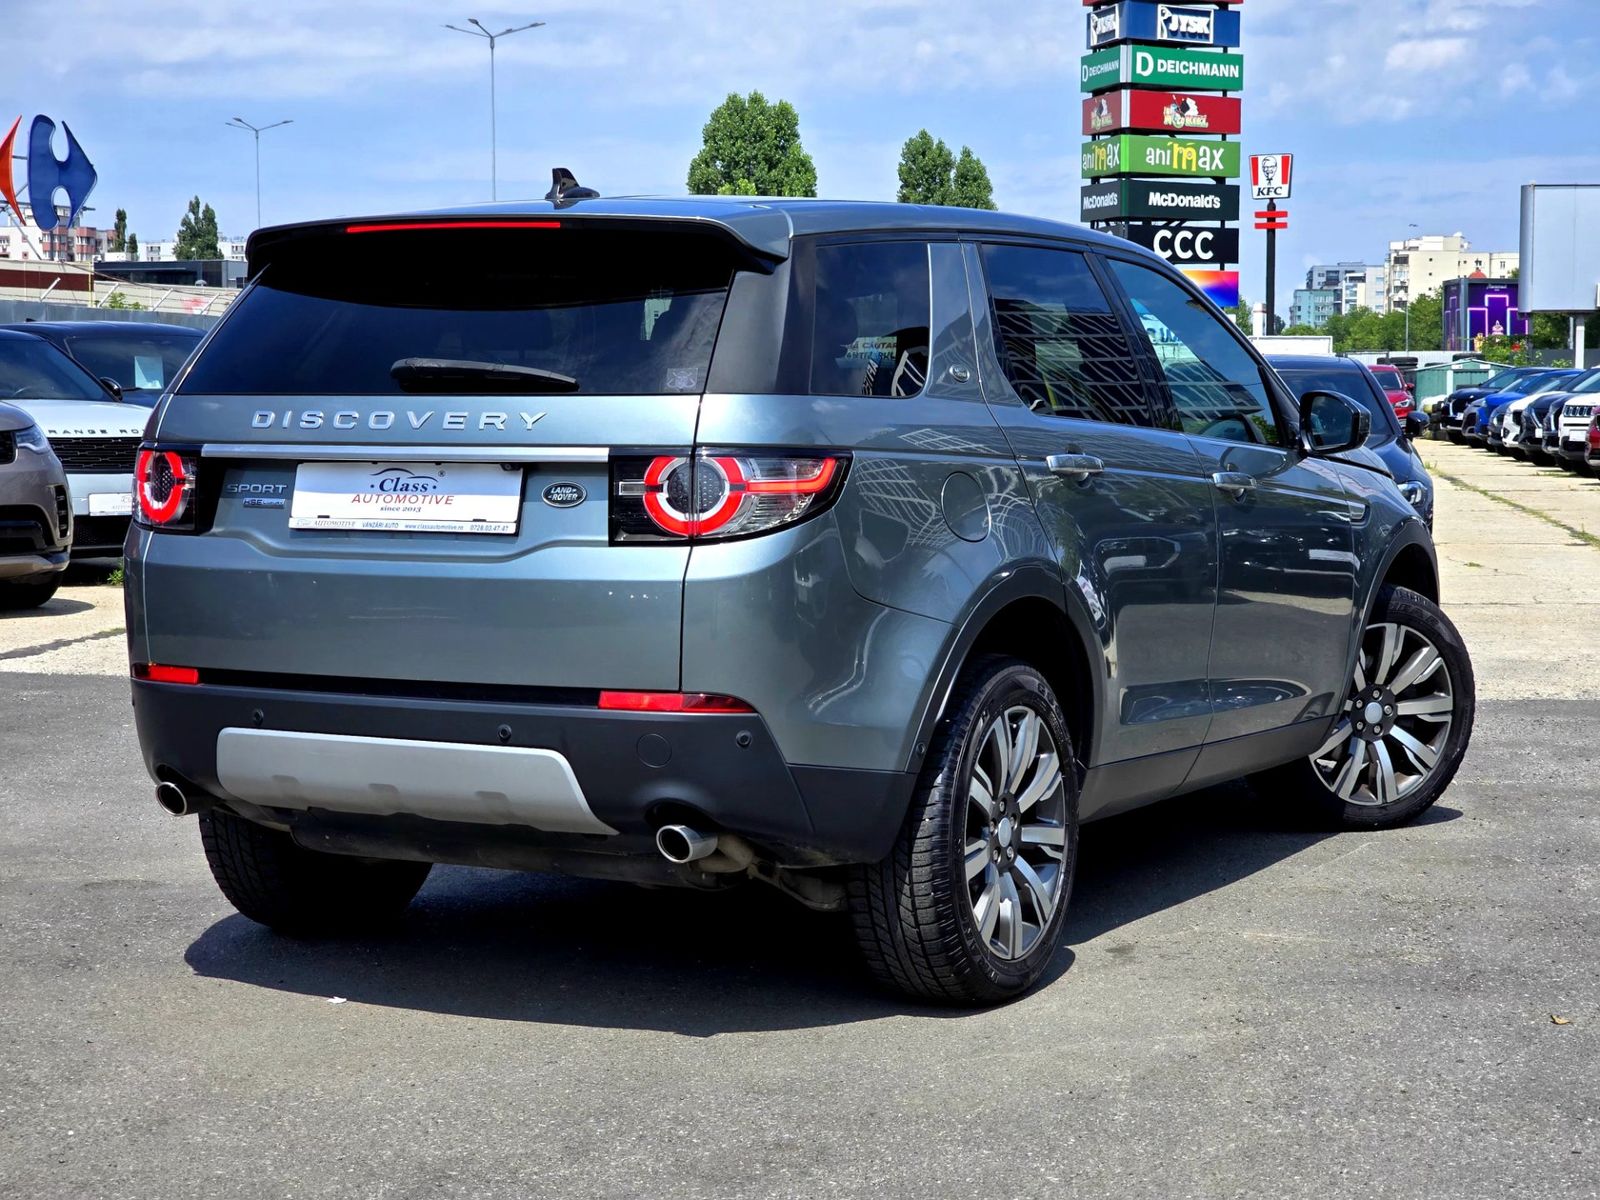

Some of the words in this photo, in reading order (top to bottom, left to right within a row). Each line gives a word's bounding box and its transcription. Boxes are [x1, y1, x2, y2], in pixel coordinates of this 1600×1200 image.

[1094, 12, 1116, 34] JYSK
[1168, 14, 1211, 35] JYSK
[1089, 58, 1120, 77] DEICHMANN
[1136, 51, 1154, 77] D
[1157, 59, 1239, 78] DEICHMANN
[1082, 191, 1118, 210] McDonald's
[1148, 191, 1221, 209] McDonald's
[1256, 186, 1283, 197] KFC
[1153, 229, 1214, 260] CCC
[251, 410, 547, 431] DISCOVERY
[226, 483, 288, 495] SPORT
[379, 477, 429, 493] Class
[351, 494, 454, 505] AUTOMOTIVE
[314, 520, 356, 528] AUTOMOTIVE
[385, 521, 399, 529] AUTO
[405, 522, 464, 531] www.classautomotive.ro
